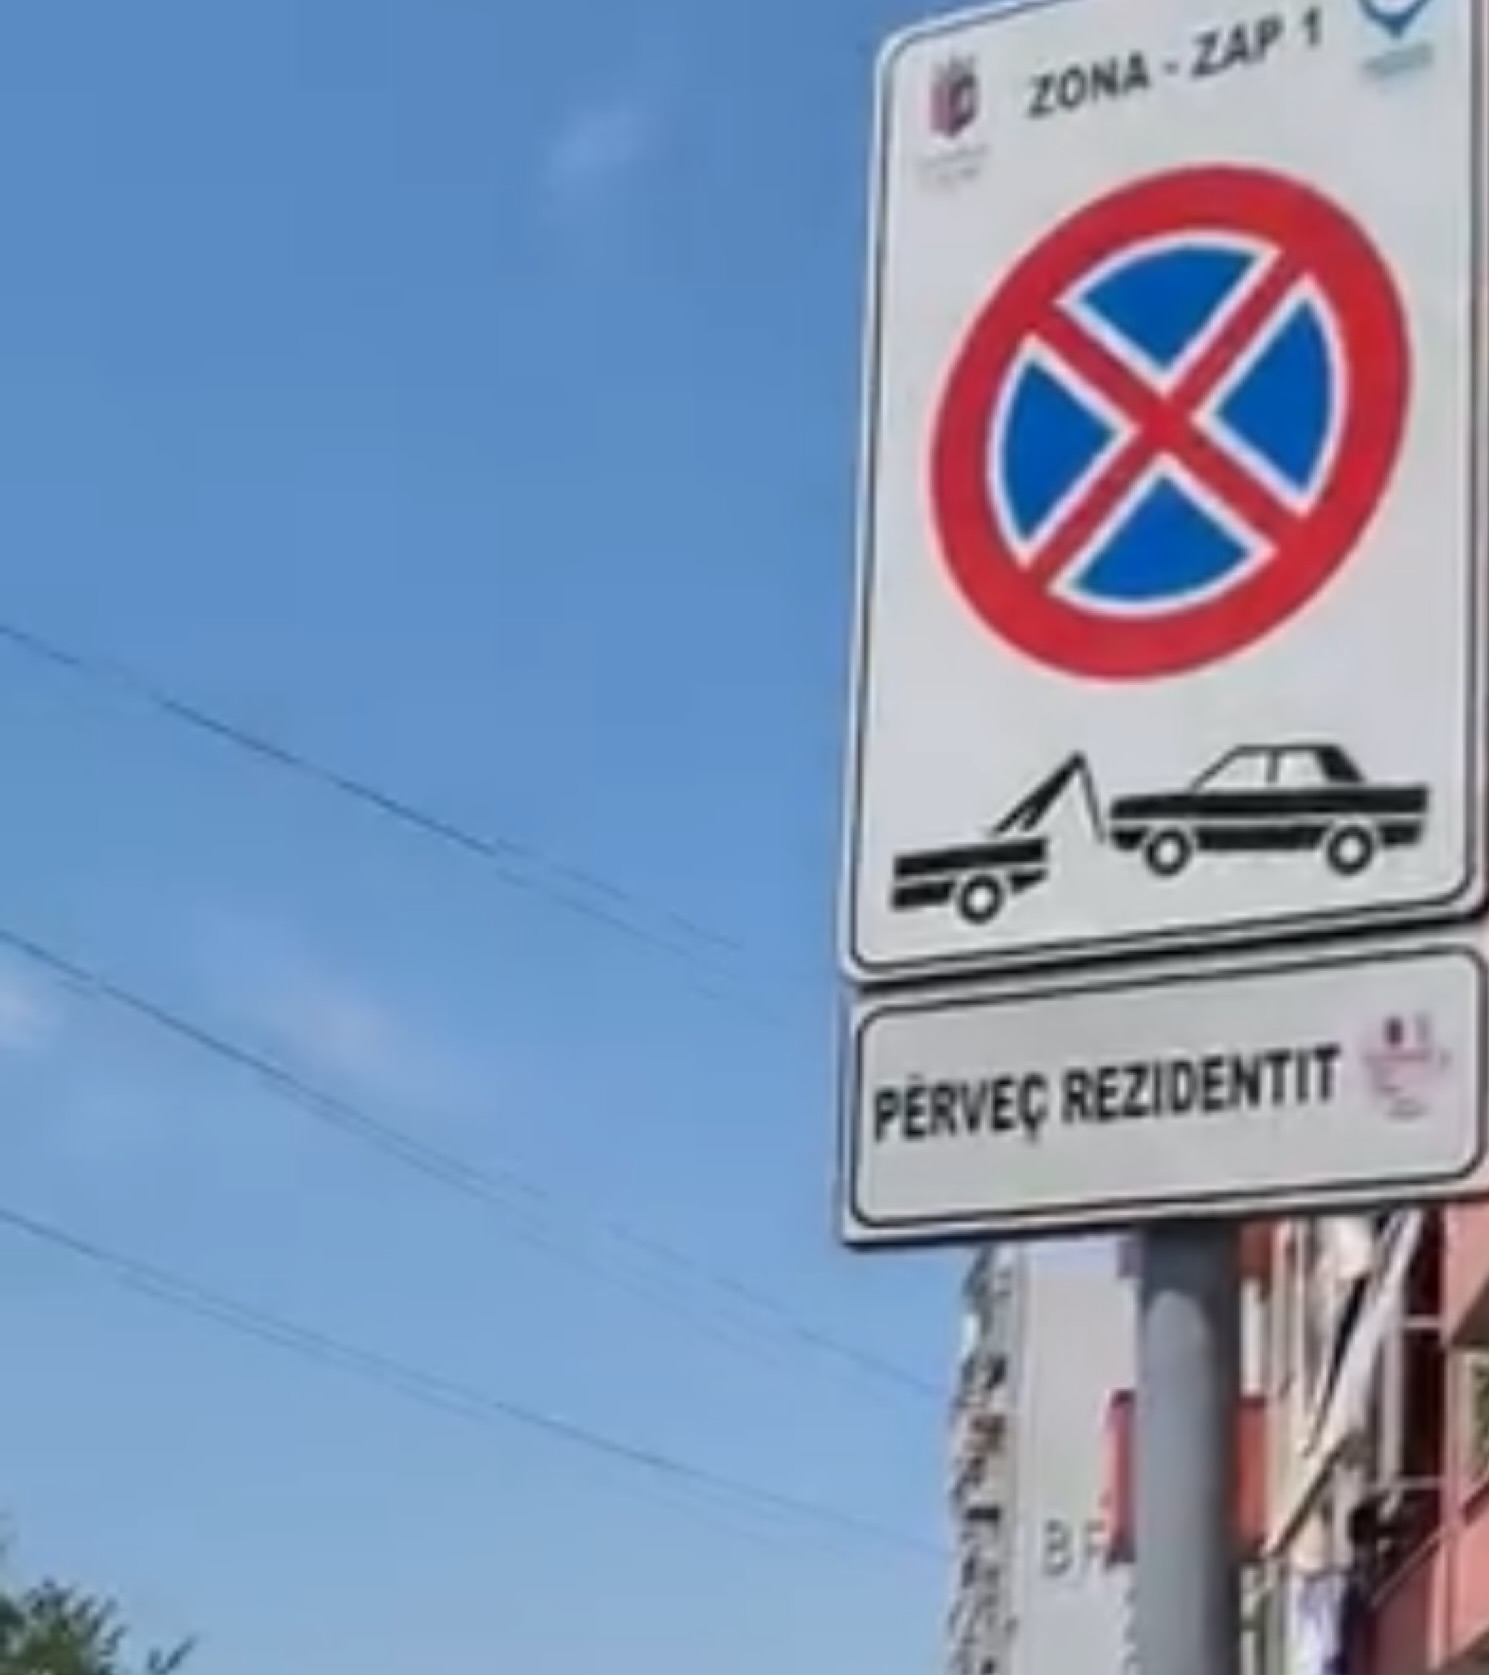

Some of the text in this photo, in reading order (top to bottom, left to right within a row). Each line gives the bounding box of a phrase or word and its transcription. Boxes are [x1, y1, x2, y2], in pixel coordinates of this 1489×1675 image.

[1027, 53, 1151, 119] ZONA
[1190, 11, 1285, 78] ZAP
[1302, 6, 1324, 46] 1
[873, 1042, 1341, 1144] PËRVEÇ REZIDENTIT
